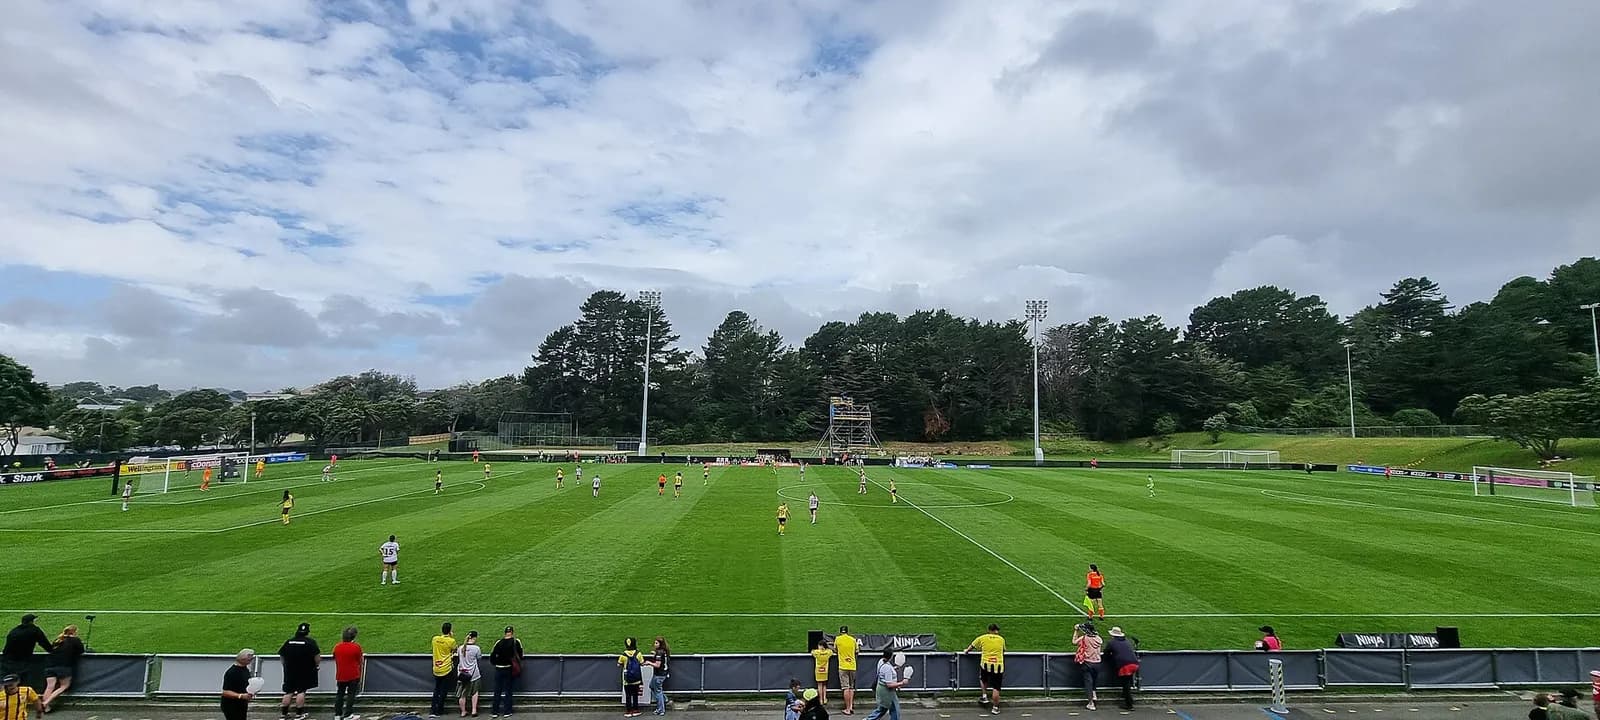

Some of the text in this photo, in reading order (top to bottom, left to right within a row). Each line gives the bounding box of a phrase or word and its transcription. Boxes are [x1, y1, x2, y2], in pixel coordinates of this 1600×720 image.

[13, 474, 43, 483] Shark
[893, 636, 920, 648] NINJA
[1355, 634, 1384, 647] NINJA
[1409, 634, 1439, 647] NINJA
